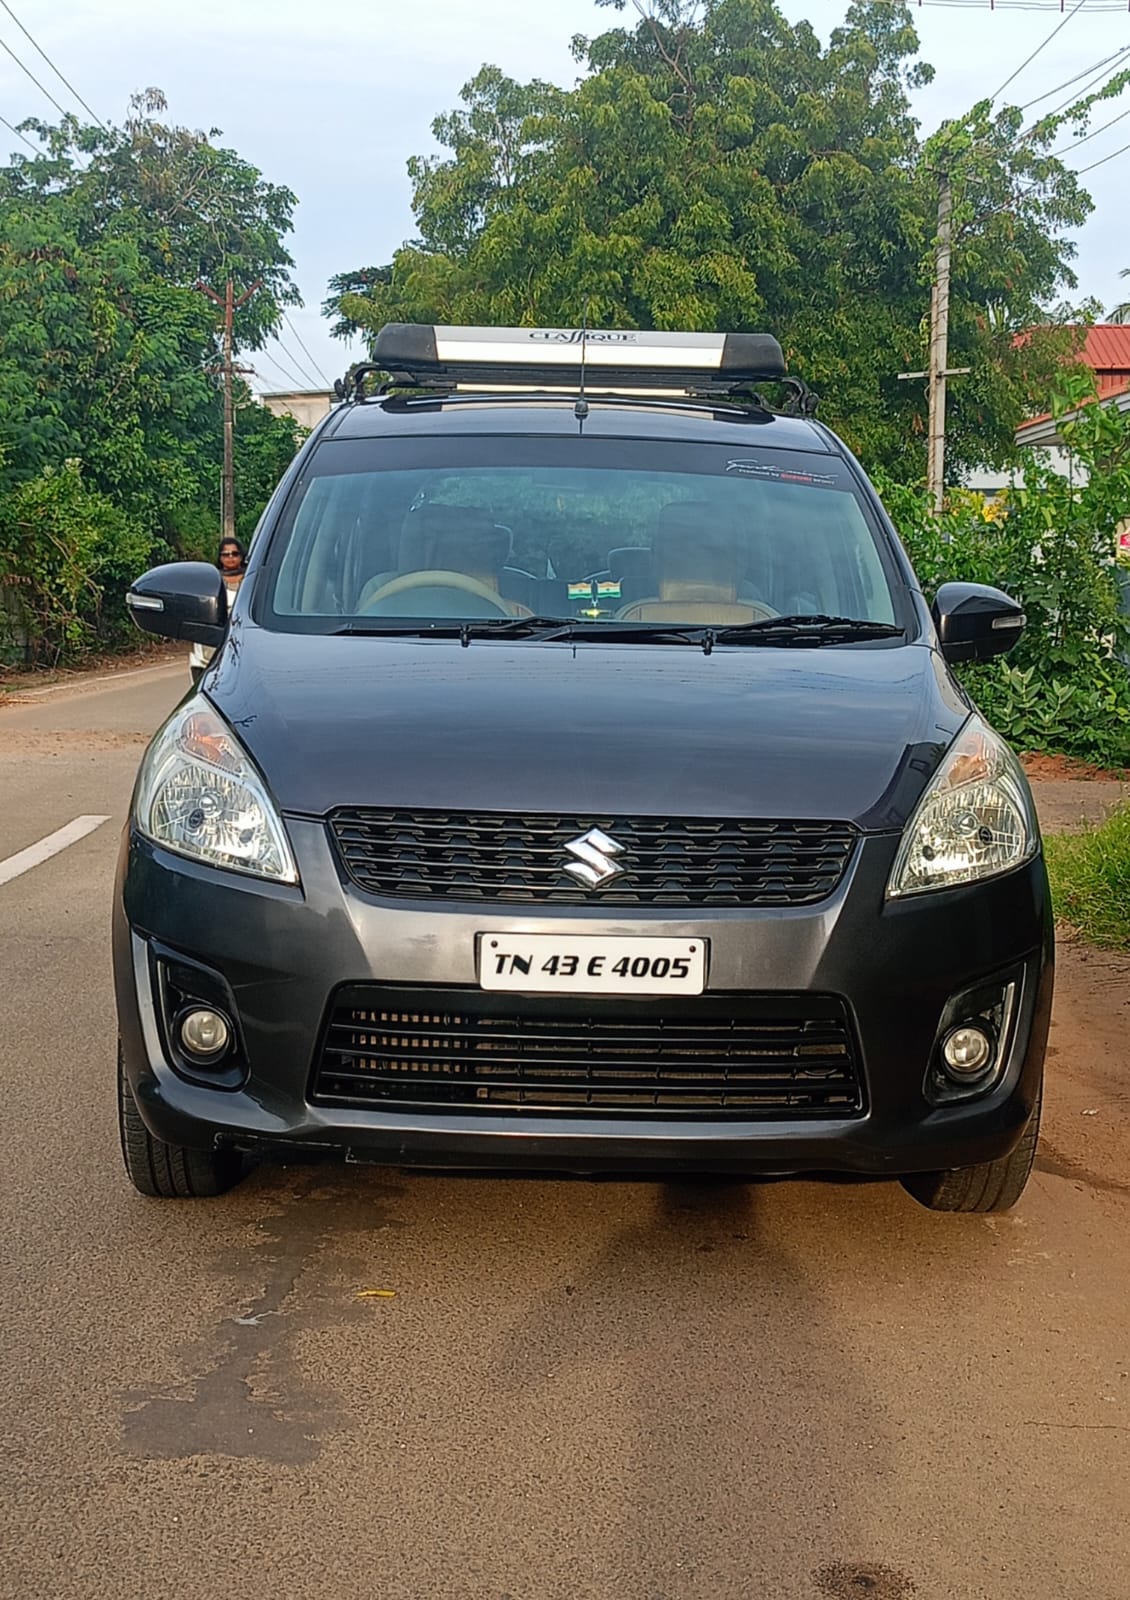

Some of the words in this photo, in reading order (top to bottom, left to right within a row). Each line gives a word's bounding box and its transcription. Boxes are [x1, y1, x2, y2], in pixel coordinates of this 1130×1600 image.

[495, 953, 533, 975] TN
[541, 955, 579, 976] 43
[586, 956, 606, 977] E
[611, 956, 692, 978] 4005
